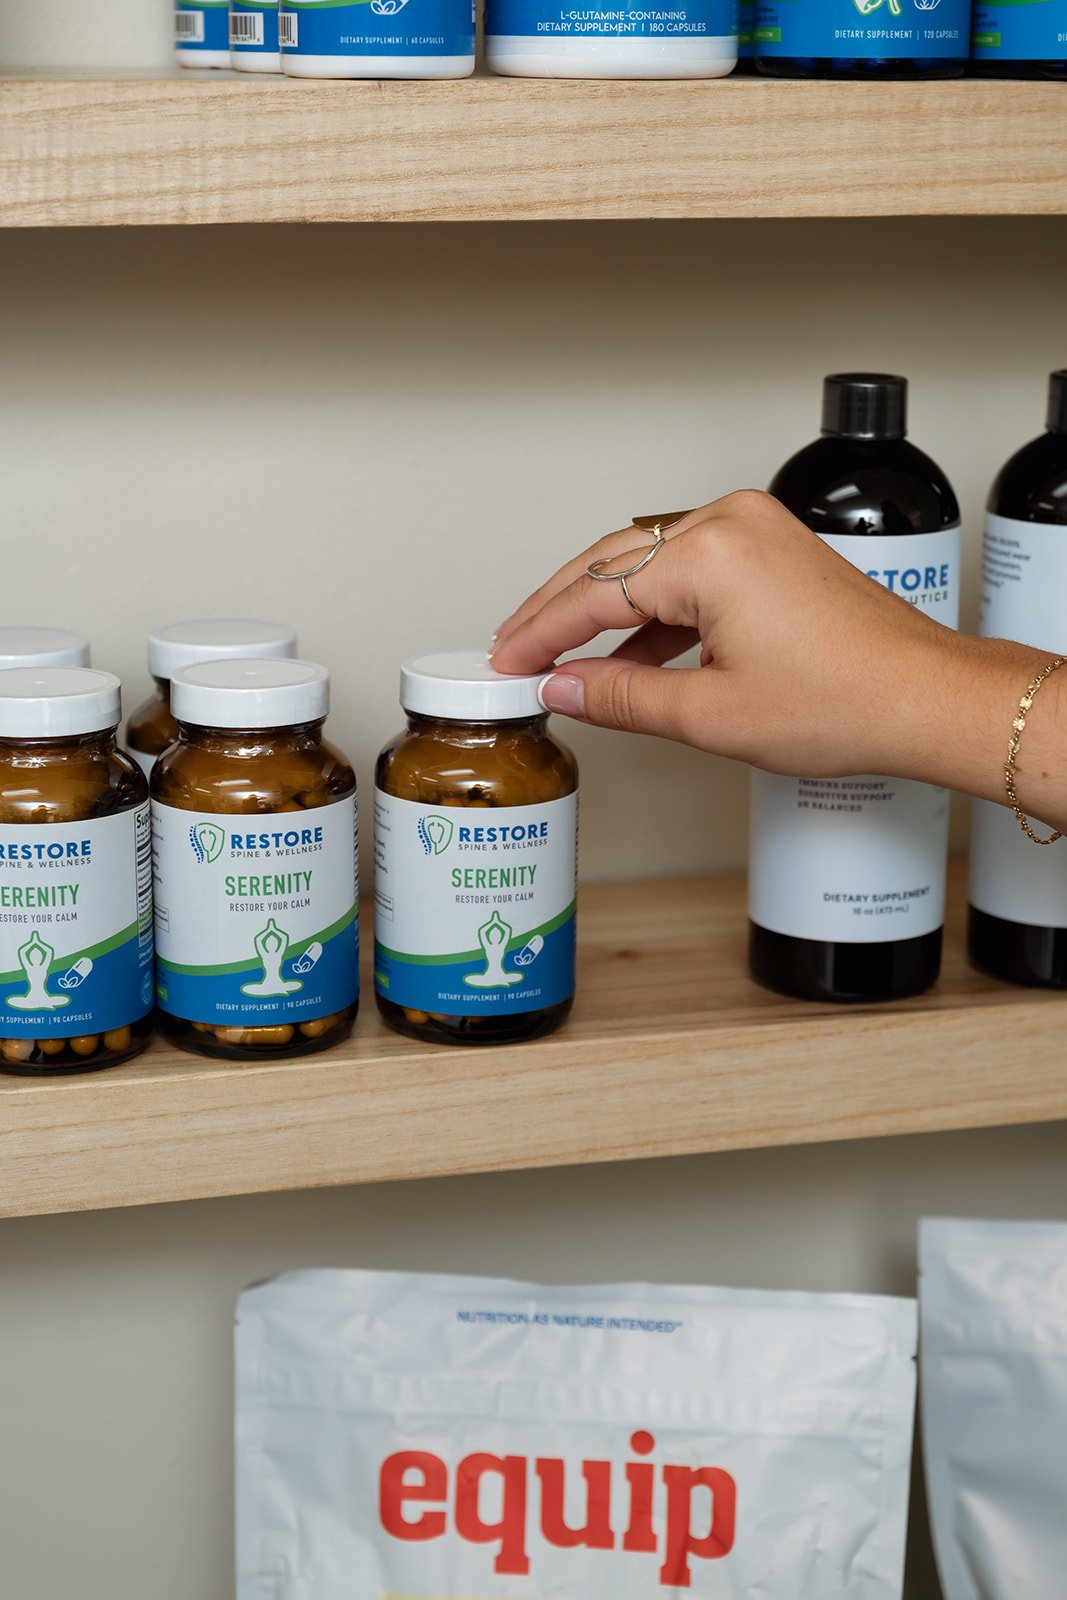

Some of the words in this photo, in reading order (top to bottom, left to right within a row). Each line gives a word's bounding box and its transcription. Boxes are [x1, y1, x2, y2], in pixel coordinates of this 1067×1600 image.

[560, 10, 687, 21] L-GLUTAMINE-CONTAINING
[536, 22, 572, 32] DIETARY
[574, 22, 637, 32] SUPPLEMENT
[649, 22, 664, 32] 180
[666, 22, 707, 32] CAPSULES
[834, 29, 864, 39] DIETARY
[866, 29, 912, 39] SUPPLEMENT
[923, 29, 934, 39] 120
[935, 29, 958, 39] CAPSULES
[340, 36, 364, 45] DIETARY
[365, 36, 403, 45] SUPPLEMENT
[419, 36, 444, 44] CAPSULES
[866, 563, 949, 592] TORE
[903, 590, 948, 605] UTICS
[230, 826, 324, 850] RESTORE
[458, 821, 549, 843] RESTORE
[230, 850, 260, 858] SPINE
[264, 850, 272, 858] &
[275, 843, 324, 857] WELLNESS
[457, 843, 488, 851] SPINE
[491, 843, 499, 851] &
[502, 838, 549, 851] WELLNESS
[0, 861, 22, 869] PINE
[27, 861, 34, 869] &
[38, 857, 92, 869] WELLNESS
[224, 870, 313, 897] SERENITY
[451, 864, 538, 889] SERENITY
[0, 883, 80, 908] ERENITY
[455, 894, 490, 904] RESTORE
[492, 894, 513, 904] YOUR
[514, 891, 535, 902] CALM
[823, 892, 869, 903] DIETARY
[871, 885, 931, 903] SUPPLEMENT
[229, 902, 265, 912] RESTORE
[267, 901, 288, 911] YOUR
[290, 898, 311, 909] CALM
[0, 914, 28, 923] ESTORE
[30, 913, 53, 923] YOUR
[55, 911, 78, 922] CALM
[437, 992, 461, 1001] DIETARY
[462, 993, 501, 1002] SUPPLEMENT
[515, 988, 542, 999] CAPSULES
[215, 1002, 239, 1011] DIETARY
[240, 1003, 279, 1011] SUPPLEMENT
[295, 996, 322, 1008] CAPSULES
[6, 1016, 45, 1024] SUPPLEMENT
[62, 1012, 93, 1023] CAPSULES
[456, 1311, 530, 1324] NUTRITION
[532, 1314, 549, 1326] AS
[551, 1315, 604, 1329] NATURE
[378, 1429, 738, 1588] equip
